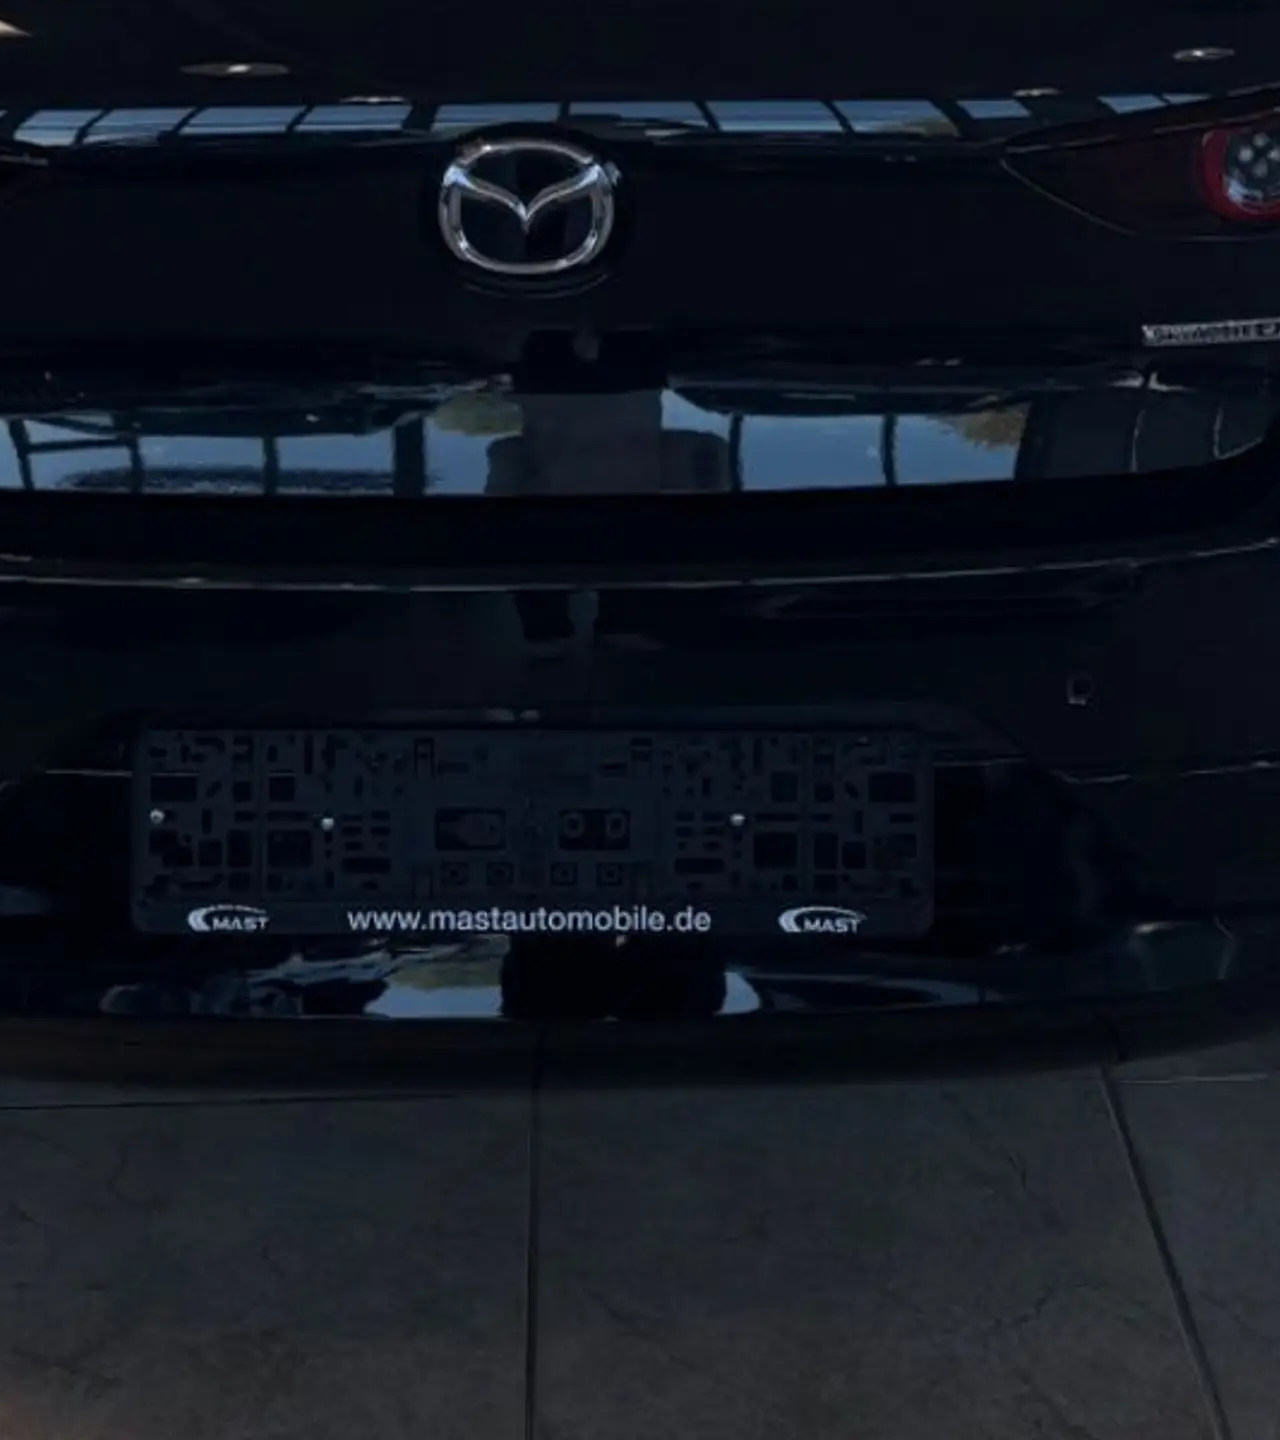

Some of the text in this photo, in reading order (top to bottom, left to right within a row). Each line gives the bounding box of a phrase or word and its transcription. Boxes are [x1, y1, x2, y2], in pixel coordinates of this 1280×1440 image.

[211, 915, 270, 931] MAST
[346, 906, 712, 932] www.mastautomobile.de
[802, 917, 860, 933] MAST
